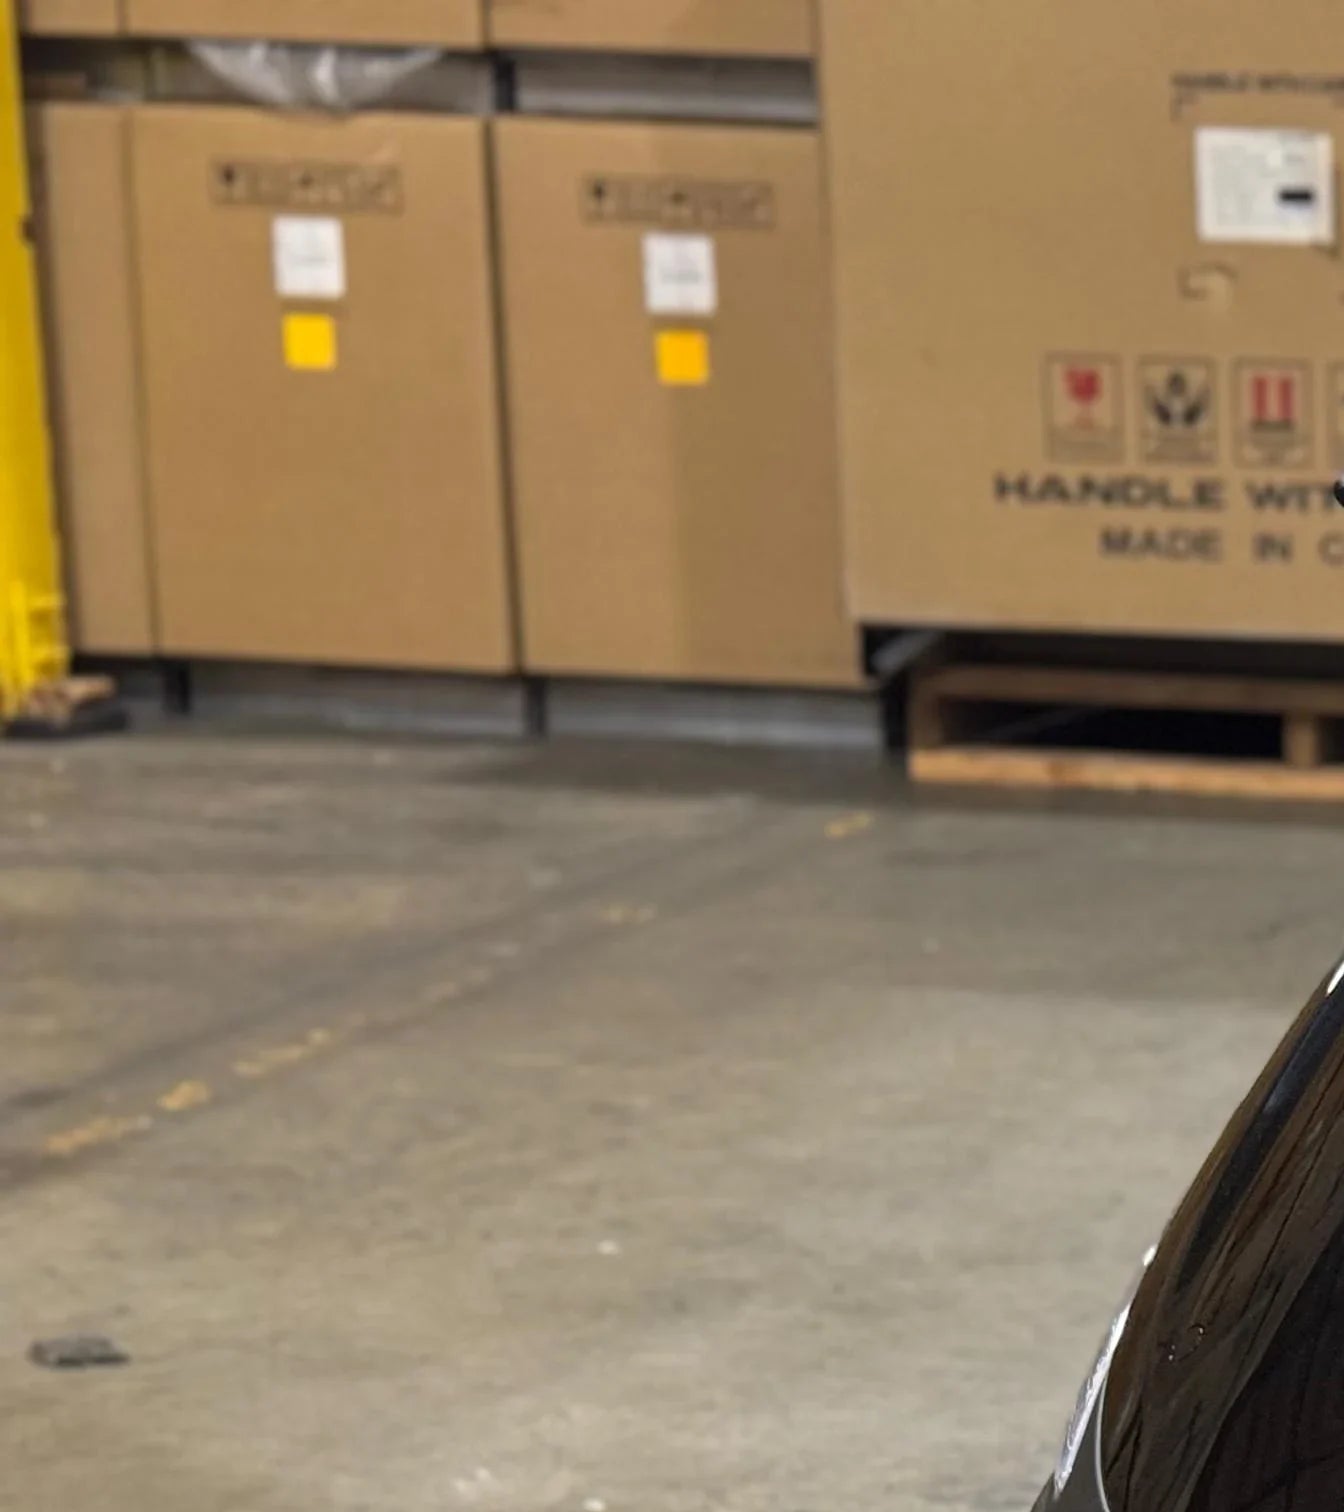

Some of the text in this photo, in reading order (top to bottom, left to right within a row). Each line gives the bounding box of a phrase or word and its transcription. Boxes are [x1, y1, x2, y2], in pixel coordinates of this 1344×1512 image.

[994, 472, 1227, 513] HANDLE
[1101, 527, 1222, 562] MADE
[1253, 532, 1293, 564] IN
